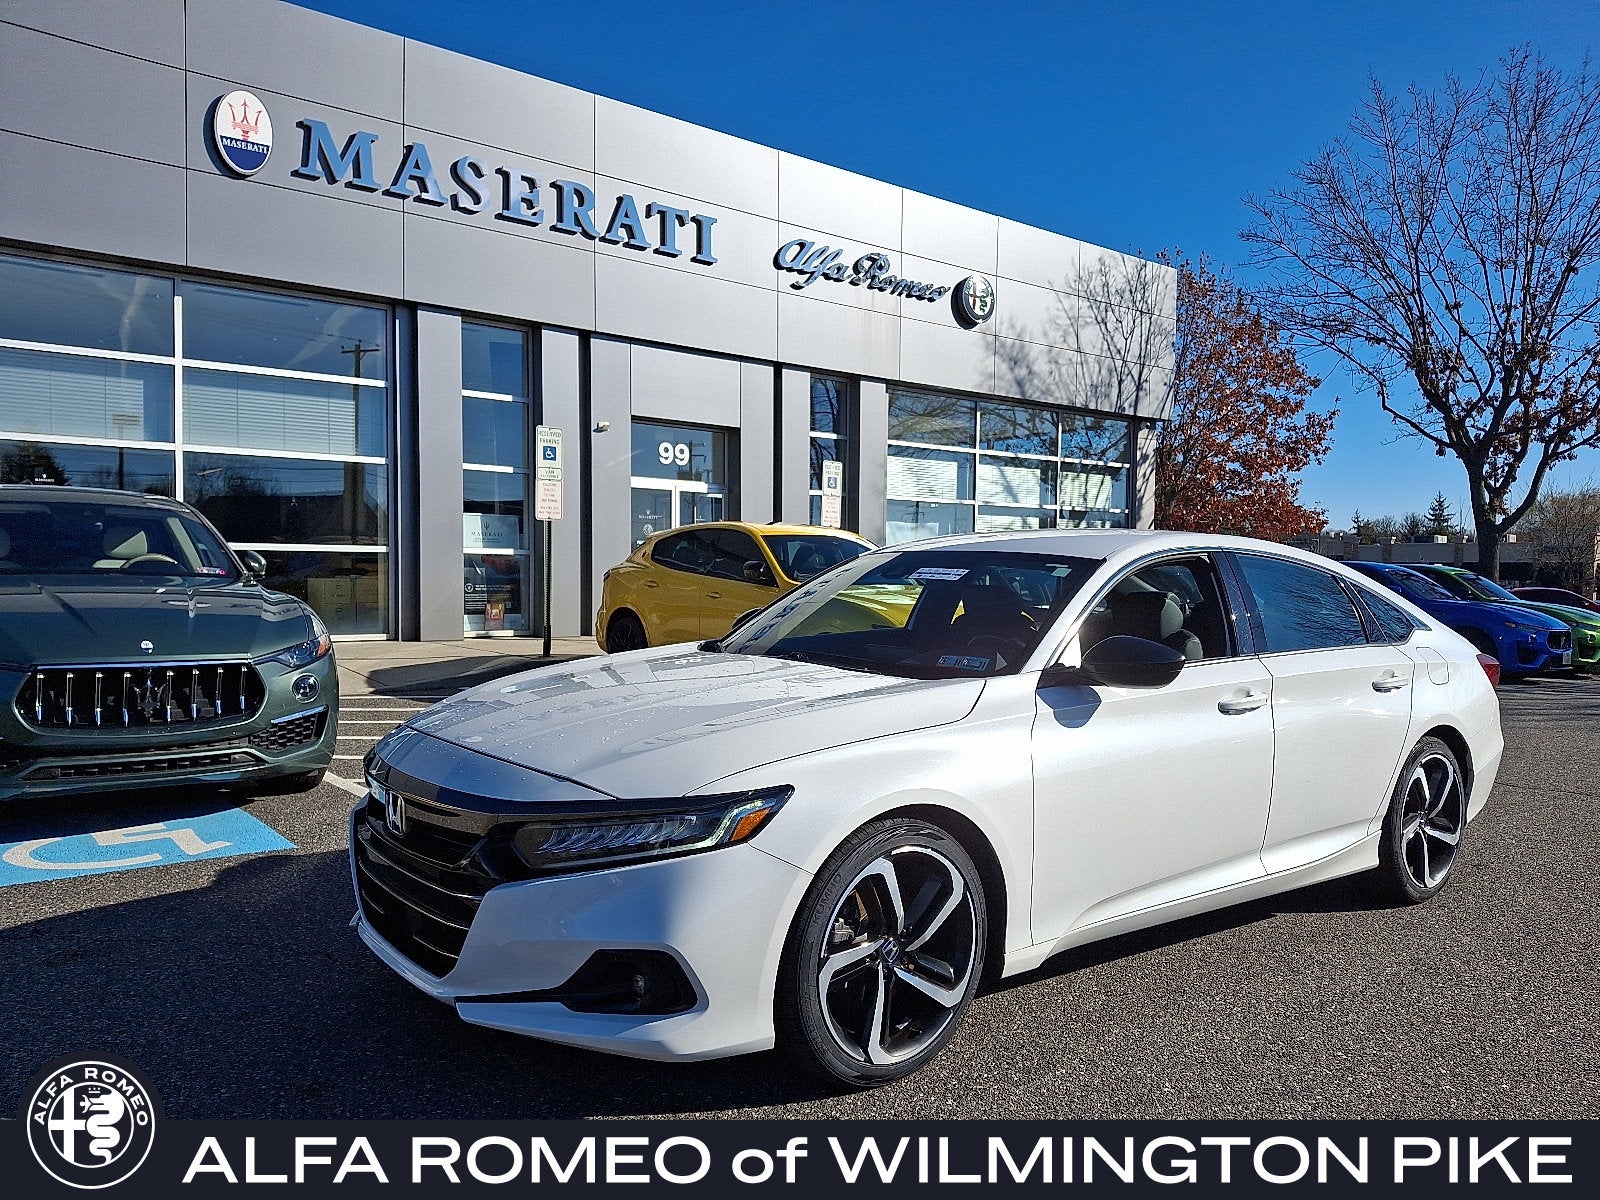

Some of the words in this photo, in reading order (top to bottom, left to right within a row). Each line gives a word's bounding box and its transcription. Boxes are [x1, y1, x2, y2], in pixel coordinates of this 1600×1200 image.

[222, 137, 267, 155] MASERATI
[293, 118, 718, 265] MASERATI
[774, 239, 851, 290] Alfa
[850, 252, 951, 302] Romeo
[658, 441, 690, 466] 99
